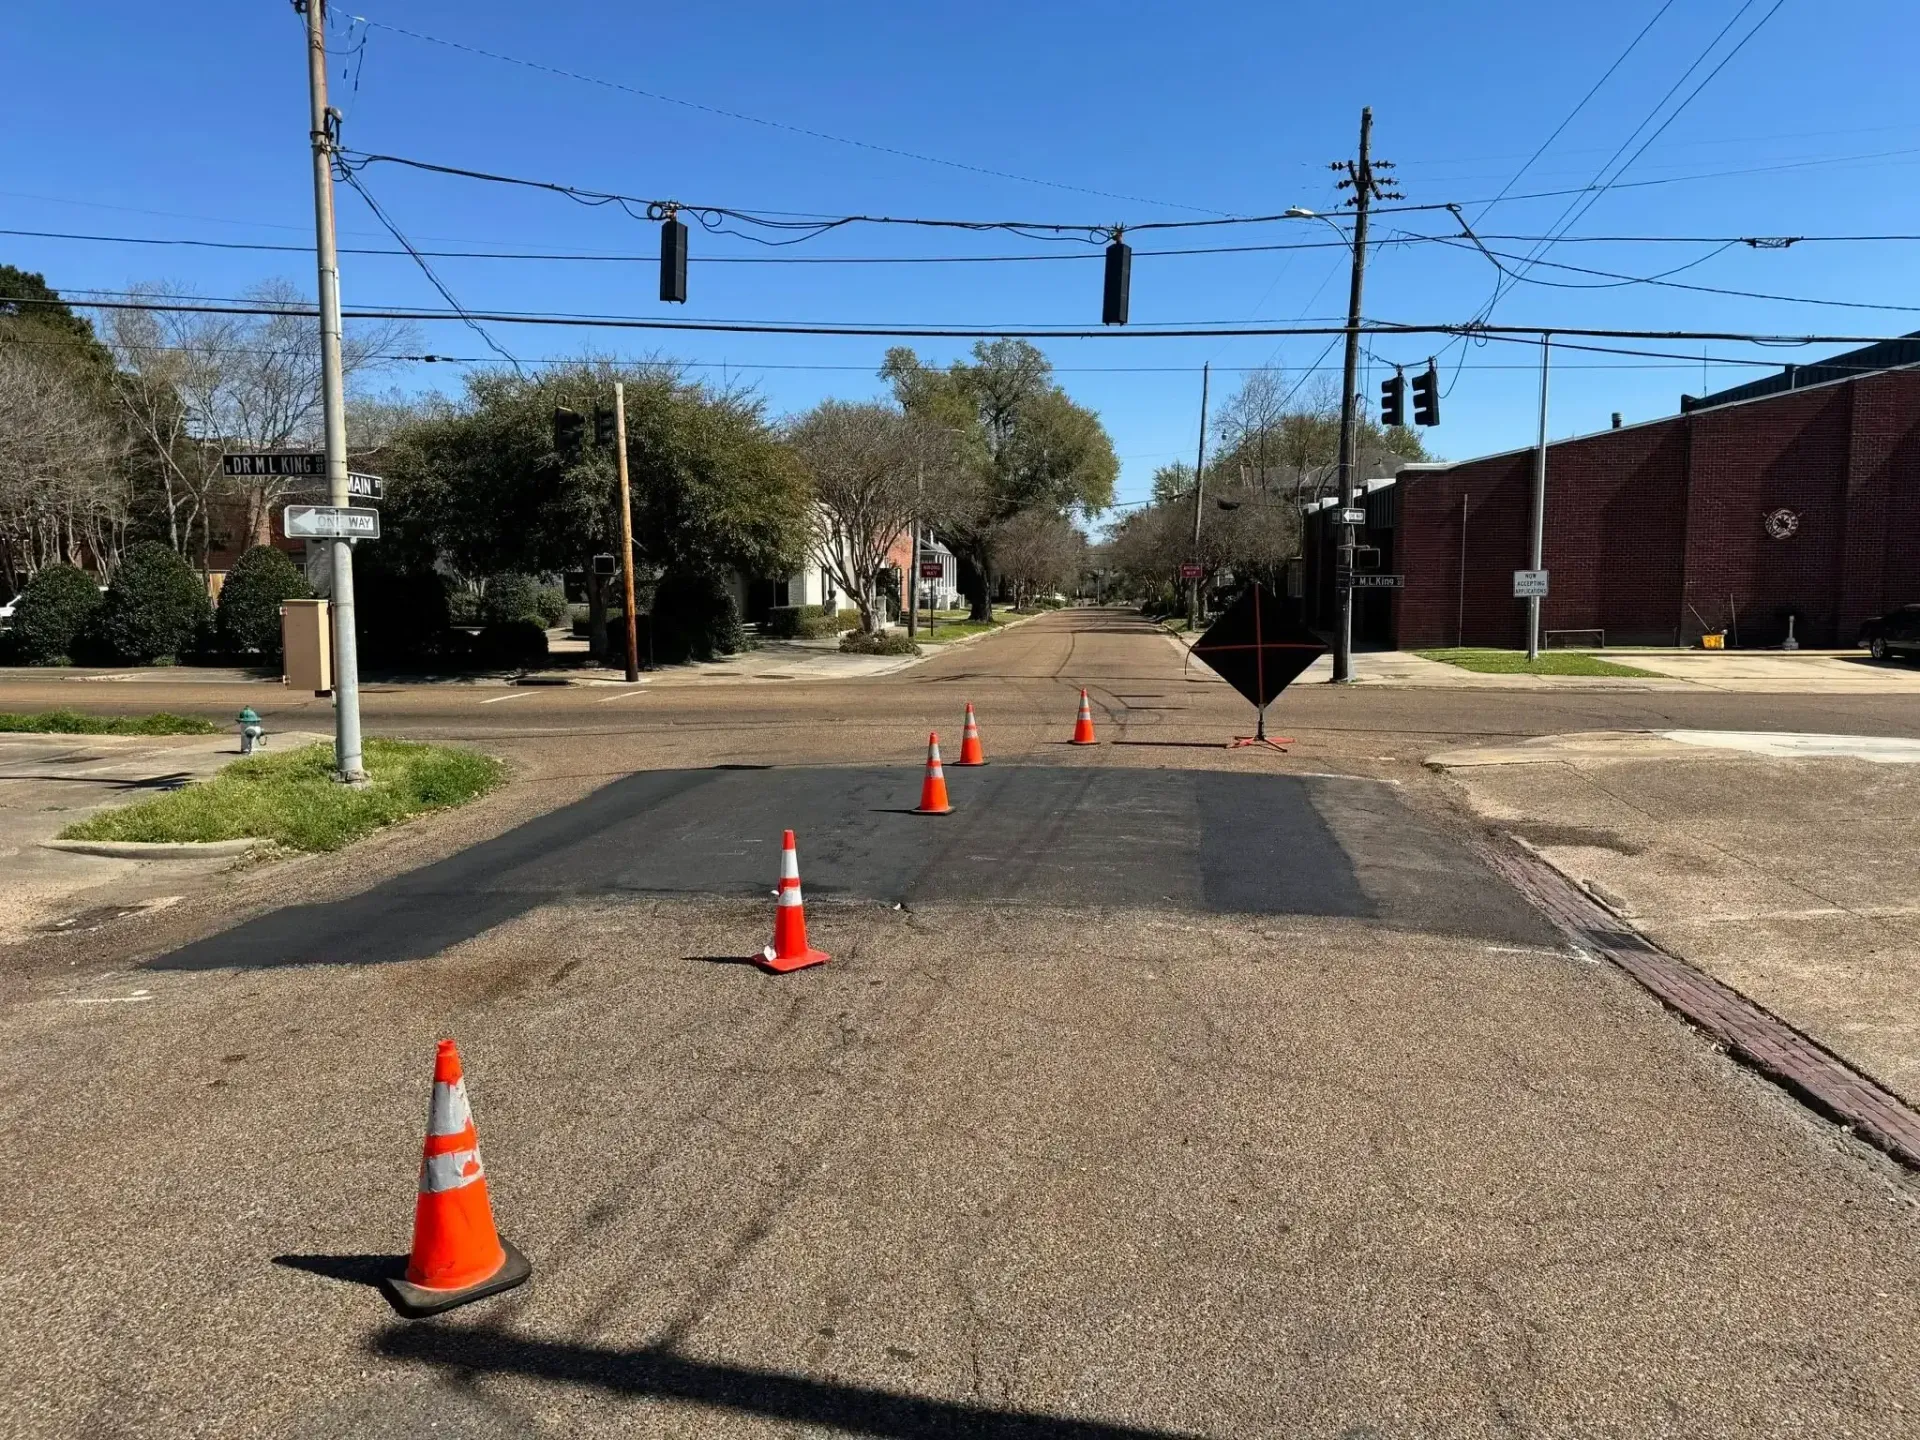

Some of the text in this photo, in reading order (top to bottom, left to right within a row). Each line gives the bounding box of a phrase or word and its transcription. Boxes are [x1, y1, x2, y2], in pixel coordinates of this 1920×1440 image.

[233, 456, 251, 474] DR
[255, 456, 265, 474] M
[268, 456, 277, 474] L
[281, 456, 311, 474] KING
[348, 475, 371, 495] MAIN
[348, 516, 371, 529] WAY
